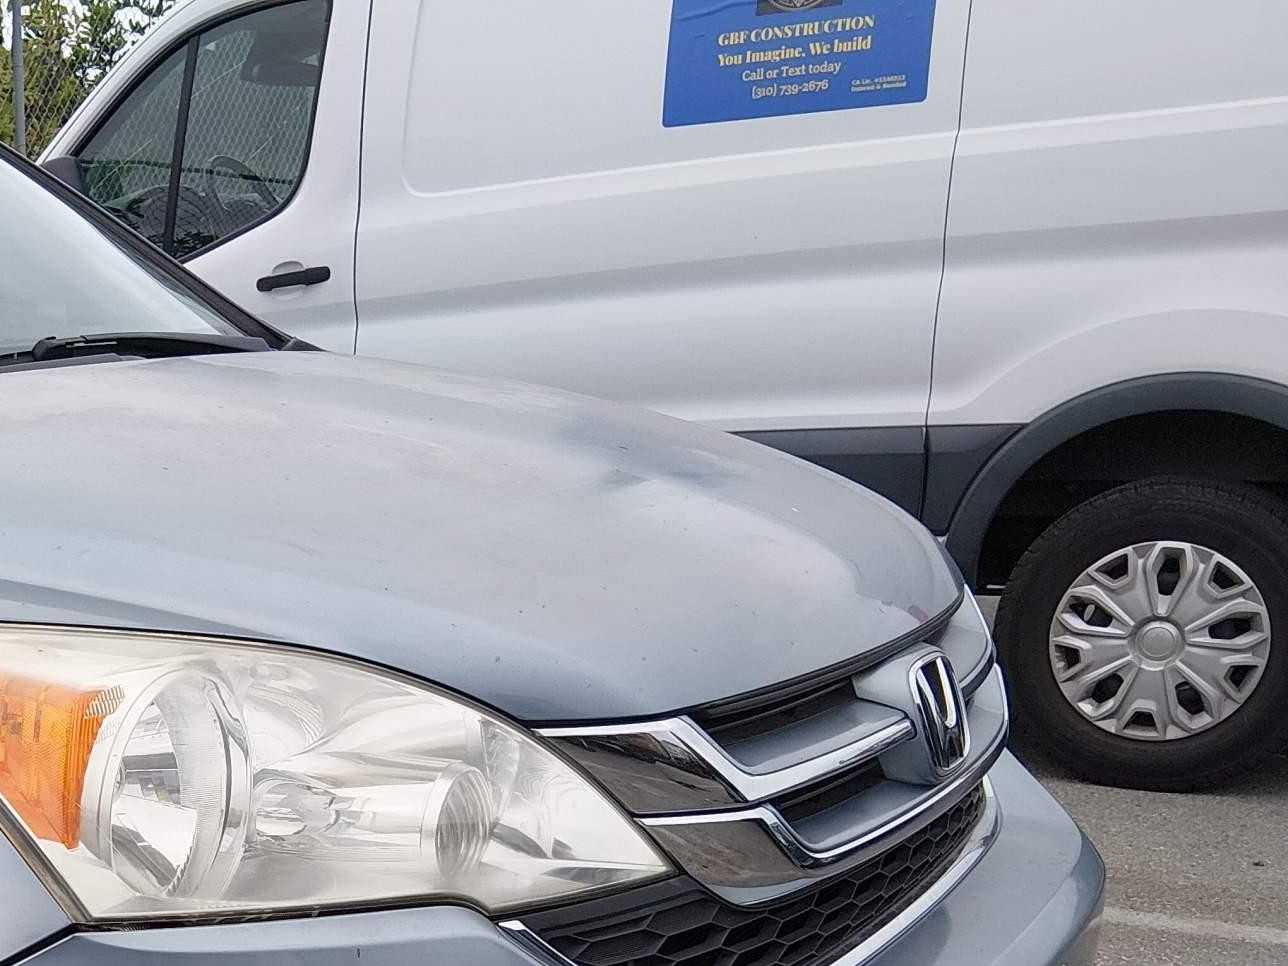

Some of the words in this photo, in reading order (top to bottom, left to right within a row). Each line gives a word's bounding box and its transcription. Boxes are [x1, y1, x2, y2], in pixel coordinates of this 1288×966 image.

[718, 31, 749, 46] GBF
[750, 15, 874, 41] CONSTRUCTION
[717, 51, 742, 66] You
[746, 46, 806, 64] Imagine.
[808, 42, 831, 55] We
[834, 35, 872, 52] build
[742, 68, 763, 81] Call
[766, 68, 778, 78] or
[781, 64, 806, 78] Text
[809, 61, 842, 75] today
[752, 83, 777, 99] (310)
